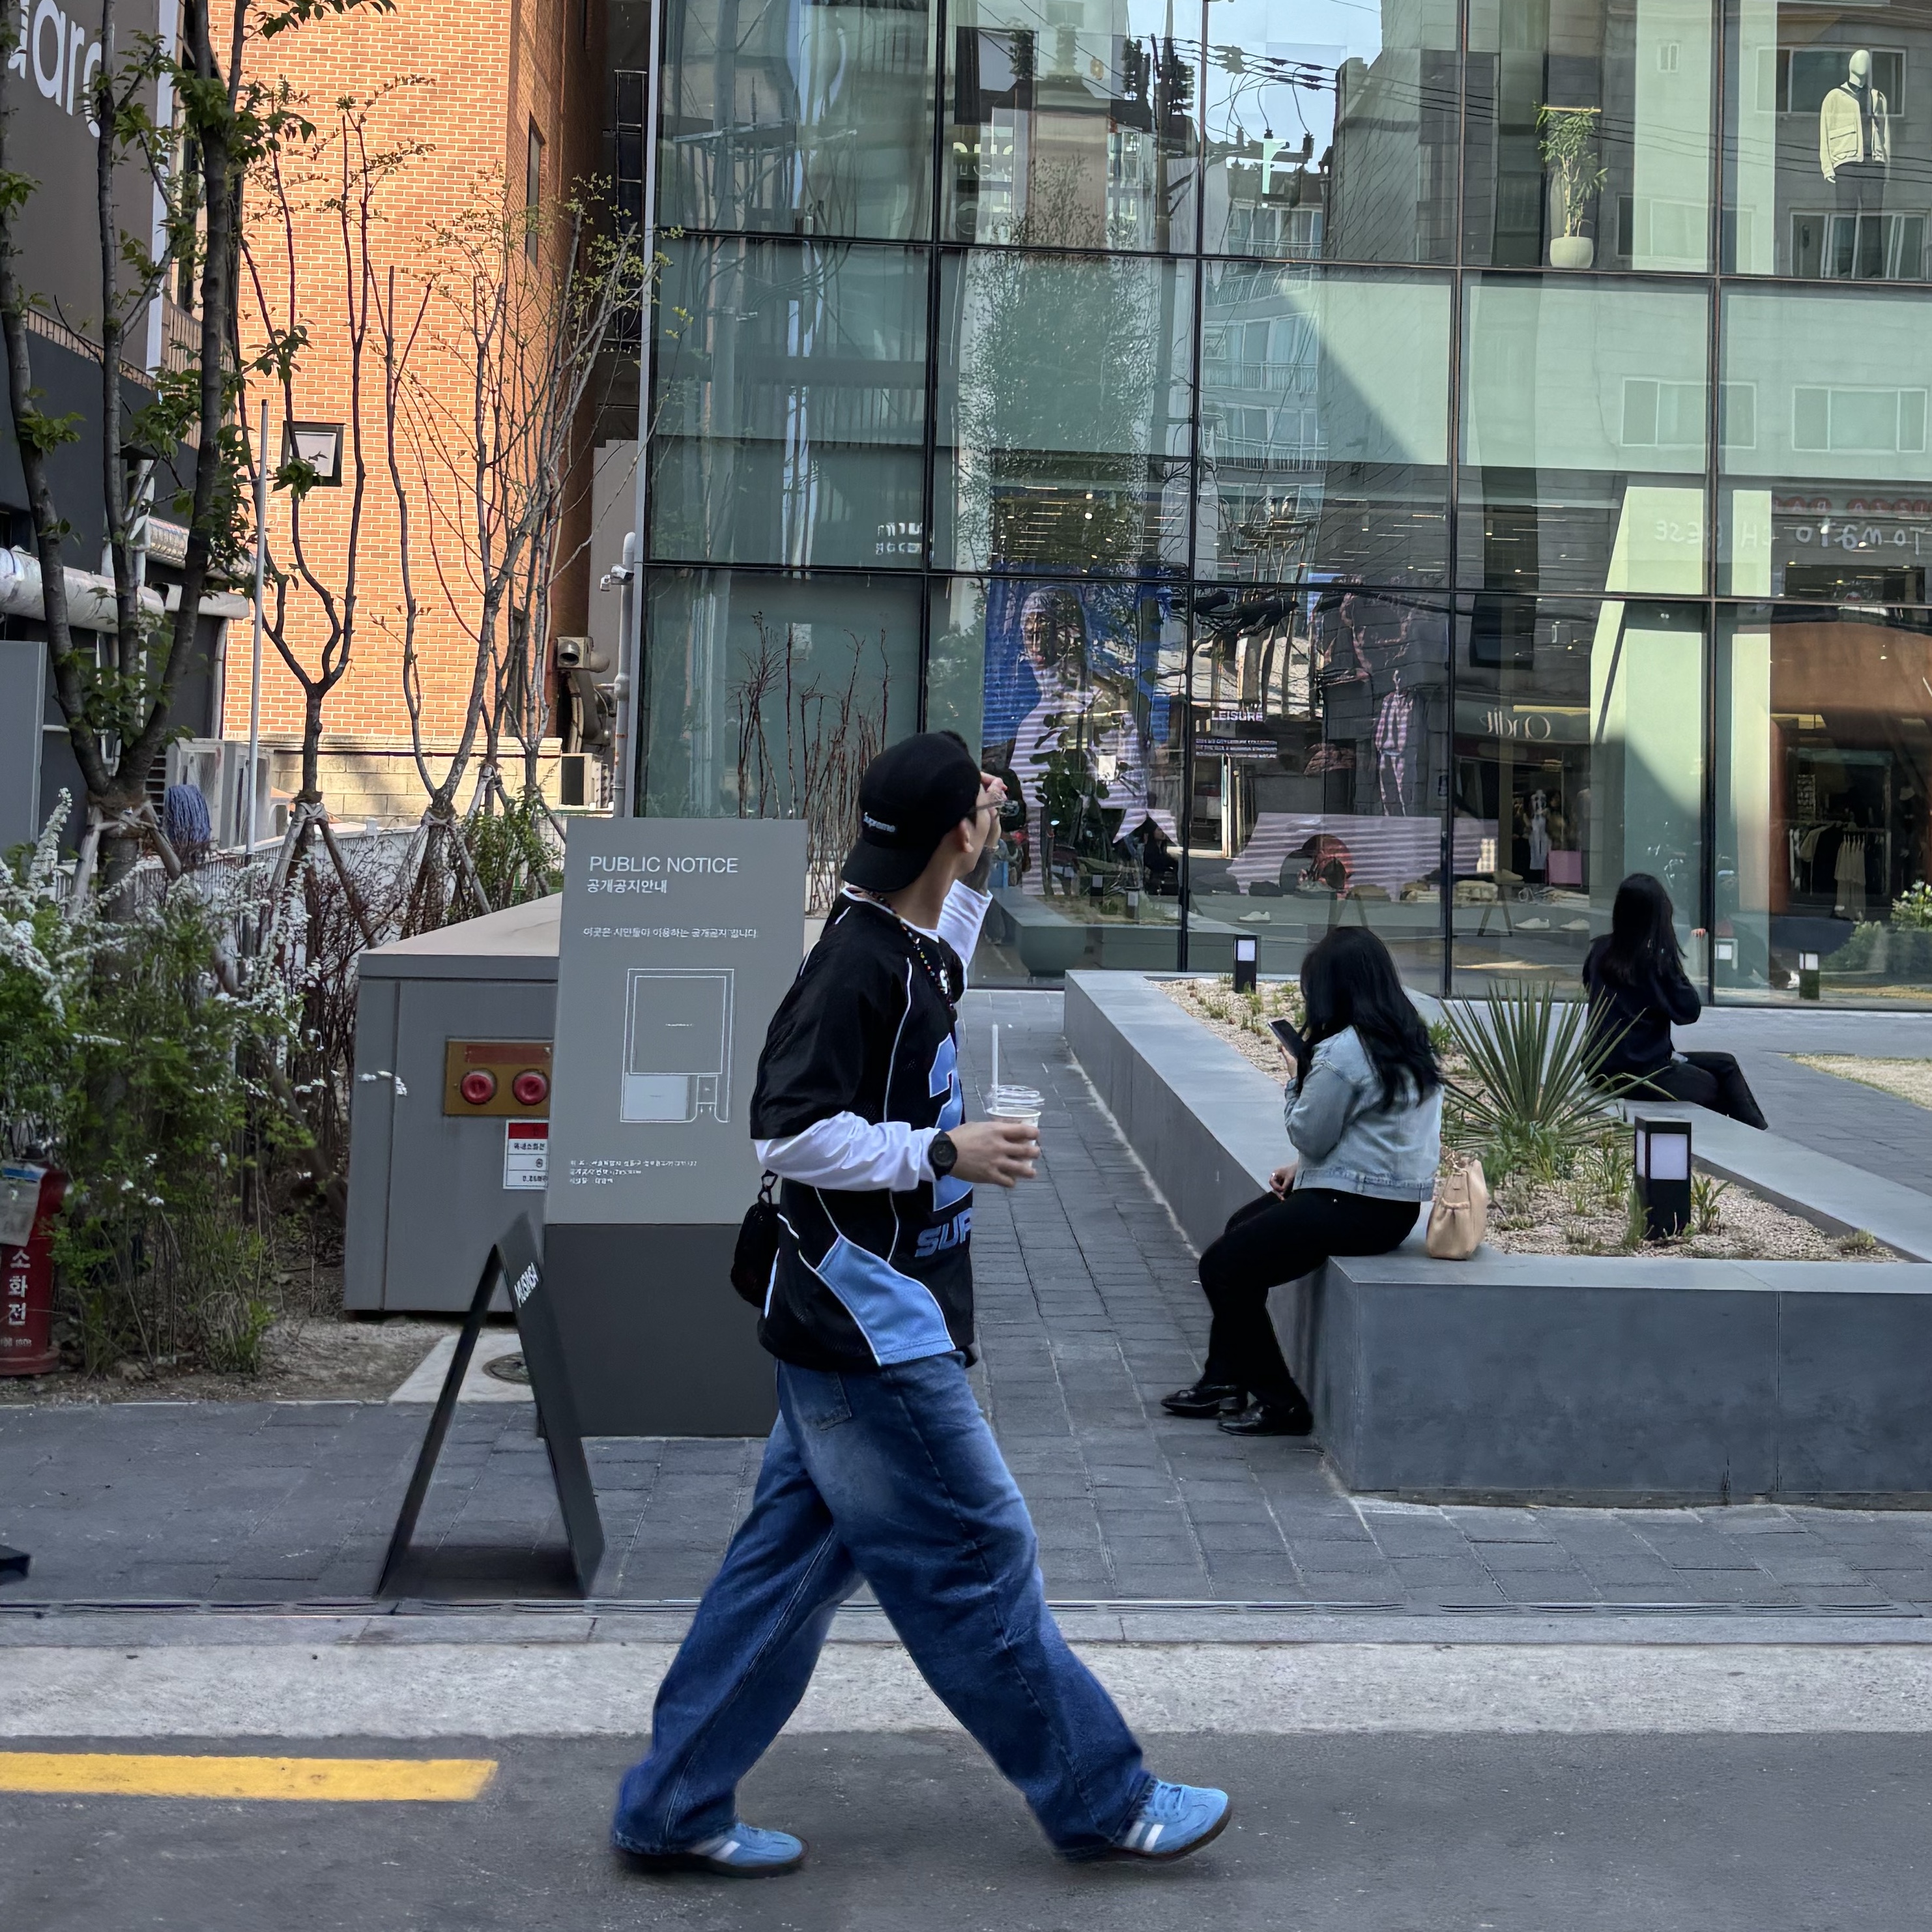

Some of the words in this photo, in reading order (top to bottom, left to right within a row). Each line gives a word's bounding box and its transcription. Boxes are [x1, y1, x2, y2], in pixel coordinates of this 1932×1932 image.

[1212, 710, 1263, 721] LEISURE
[589, 856, 661, 872] PUBLIC
[667, 857, 739, 873] NOTICE
[587, 878, 667, 893] 공개공지안내
[8, 1249, 31, 1327] 소화전
